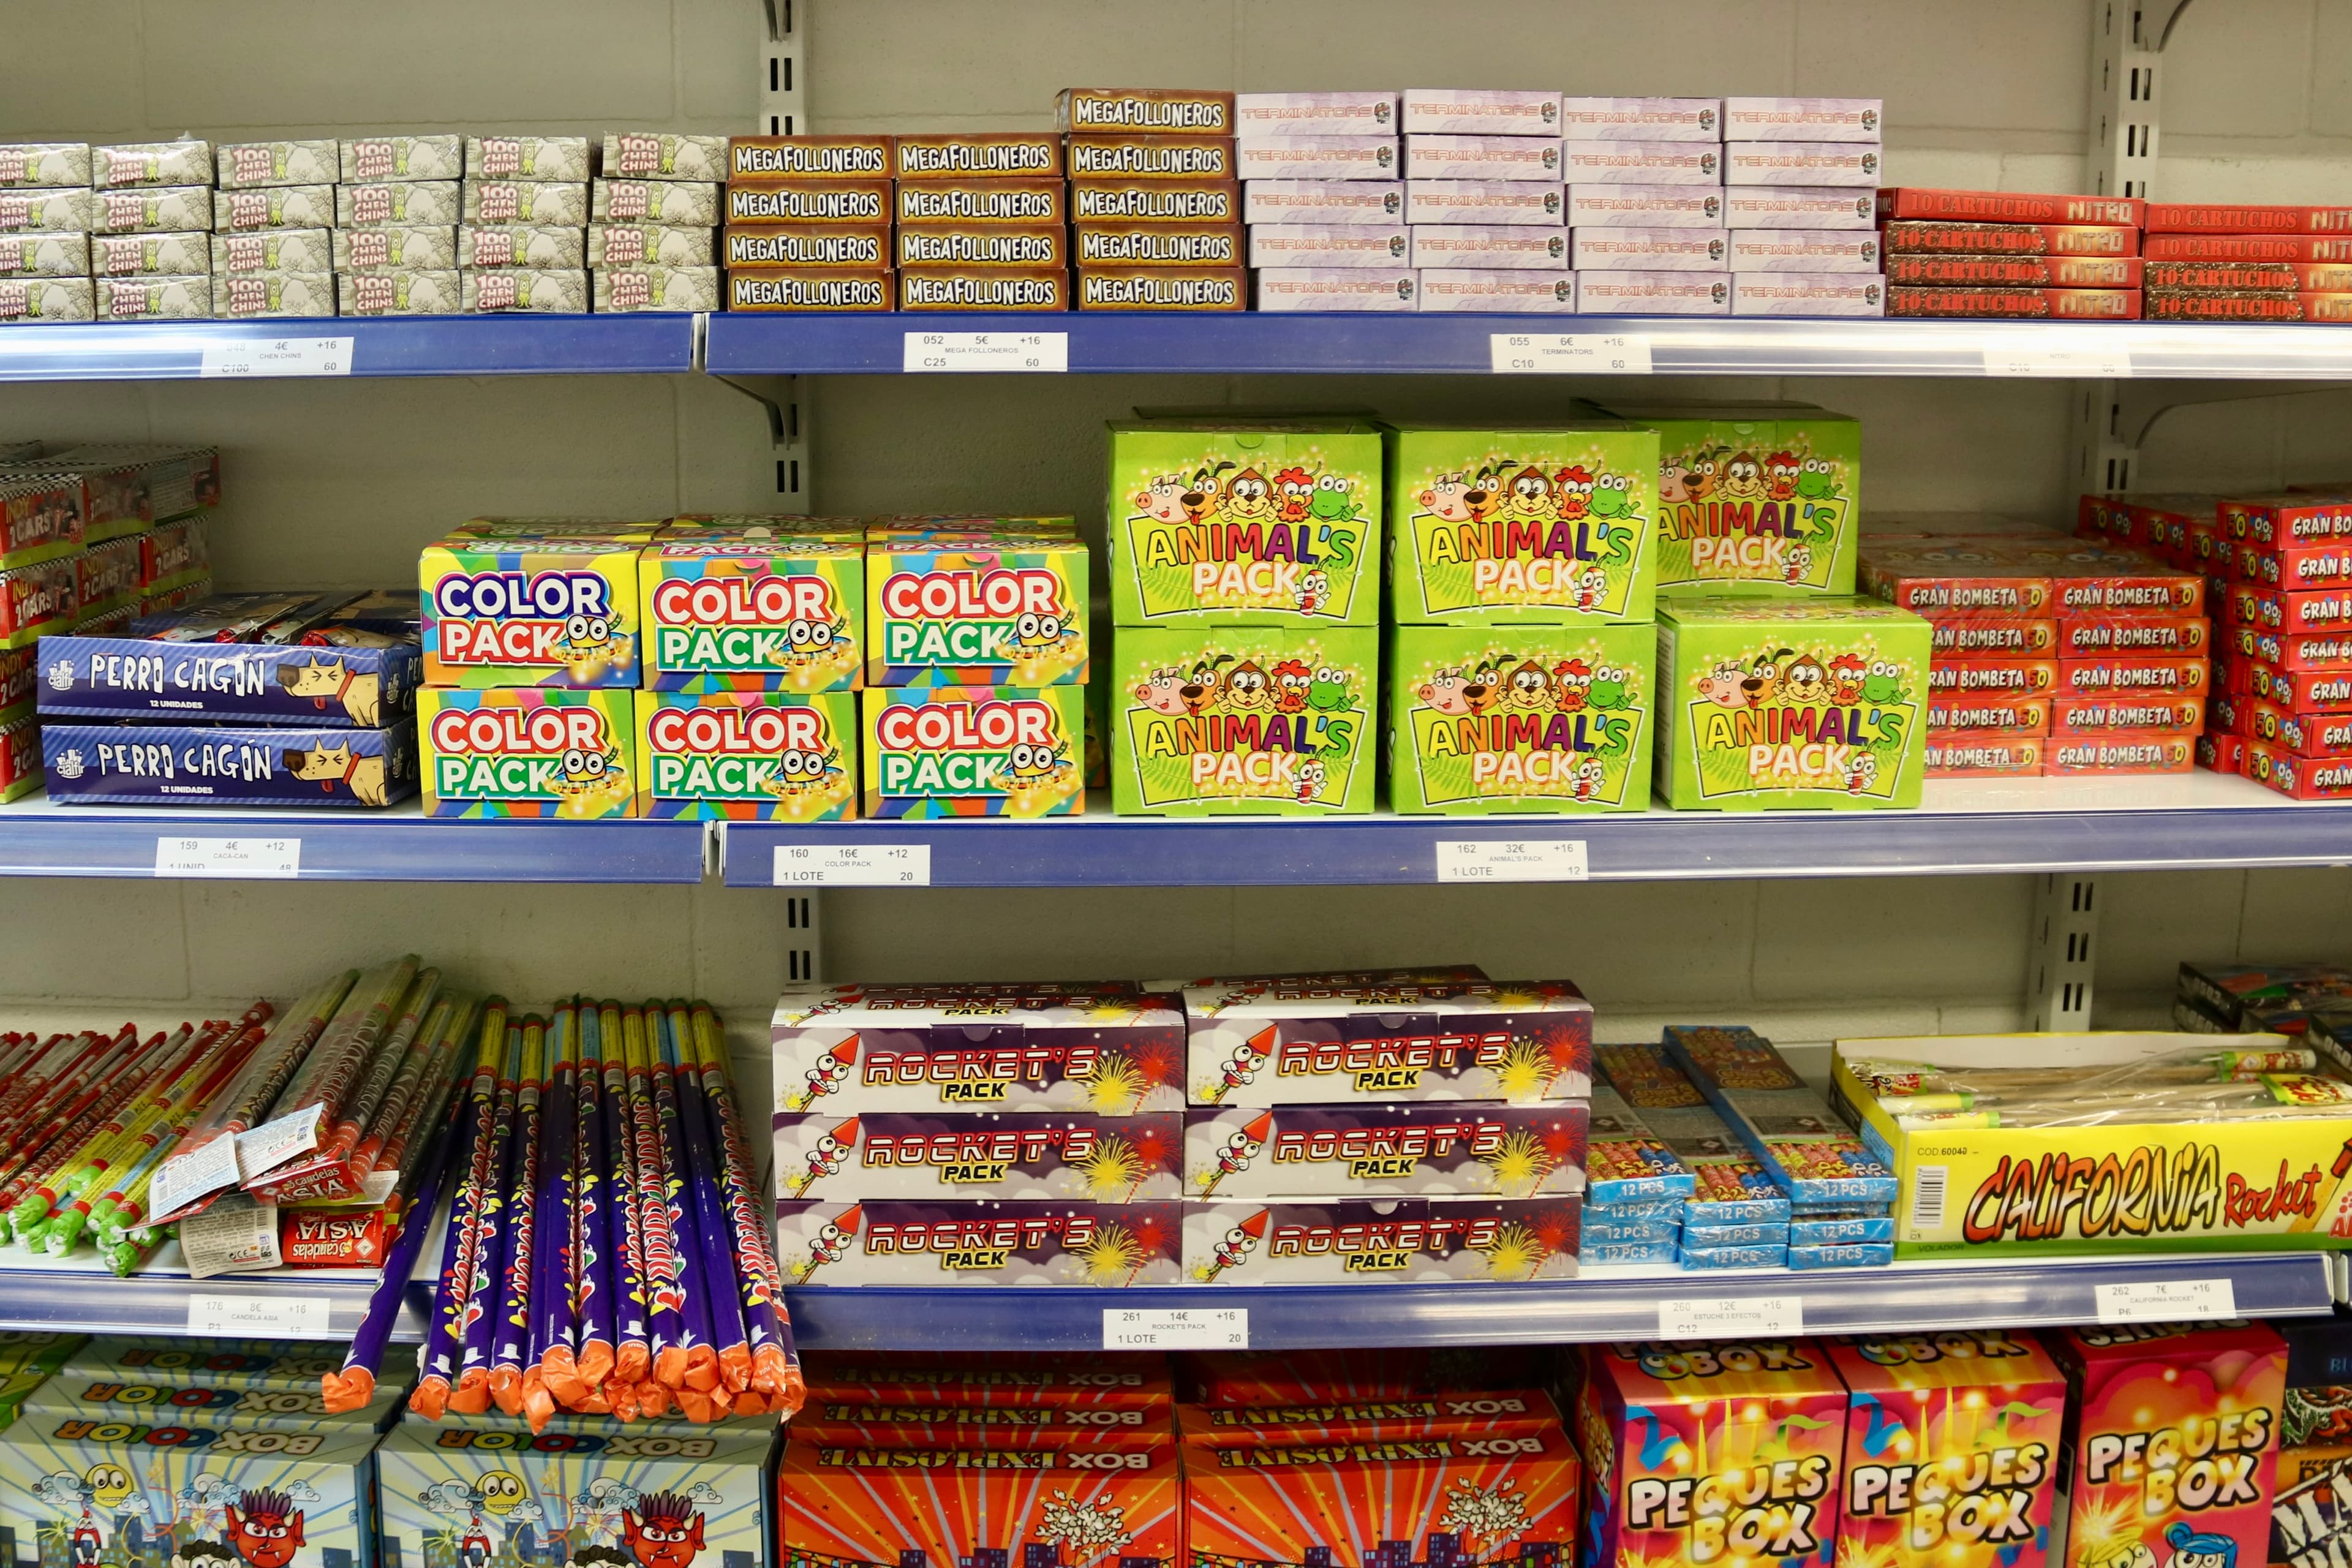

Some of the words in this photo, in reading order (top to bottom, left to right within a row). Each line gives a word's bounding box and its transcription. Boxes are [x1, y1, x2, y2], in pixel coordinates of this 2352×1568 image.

[1076, 98, 1223, 128] MEGAFOLLONEROS
[1242, 107, 1372, 119] TERMINATORS
[1411, 104, 1540, 116] TERMINATORS
[1567, 111, 1697, 124] TERMINATORS
[1732, 111, 1862, 124] TERMINATORS
[620, 138, 658, 153] 100
[233, 148, 271, 162] 100
[622, 150, 658, 162] CHEN
[736, 145, 884, 173] MEGAFOLLONEROS
[902, 145, 1050, 172] MEGAFOLLONEROS
[236, 159, 271, 171] CHEN
[622, 159, 658, 172] CHINS
[236, 167, 271, 182] CHINS
[1910, 194, 1932, 213] 10
[1938, 195, 2053, 218] CARTUCHOS
[2068, 202, 2132, 222] NITRO
[1086, 278, 1234, 304] MEGAFOLLONEROS
[1740, 287, 1865, 299] TERMINATORS
[1898, 293, 1917, 311] 10
[1924, 293, 2044, 313] CARTUCHOS
[2059, 295, 2127, 315] NITRO
[275, 342, 288, 350] 4€
[317, 341, 336, 349] +16
[924, 336, 944, 344] 052
[975, 336, 989, 344] 5€
[1020, 336, 1040, 345] +16
[1510, 337, 1529, 345] 055
[1560, 337, 1574, 345] 6€
[1604, 337, 1624, 346] +16
[222, 364, 249, 372] C100
[324, 362, 336, 371] 60
[924, 358, 946, 366] C25
[1026, 358, 1039, 367] 60
[1512, 359, 1534, 368] C10
[1611, 360, 1624, 368] 60
[1148, 521, 1355, 568] ANIMAL'S
[1193, 560, 1302, 596] PACK
[884, 573, 1058, 620] COLOR
[1910, 588, 1948, 606] GRAN
[1952, 587, 2017, 606] BOMBETA
[2022, 587, 2042, 606] 50
[2065, 587, 2103, 606] GRAN
[2107, 587, 2169, 606] BOMBETA
[2174, 586, 2193, 605] 50
[888, 622, 1012, 662] PACK
[91, 654, 164, 693] PERRO
[160, 700, 203, 709] UNIDADES
[434, 710, 603, 753] COLOR
[1708, 707, 1905, 752] ANIMAL'S
[97, 743, 175, 780] PERRO
[1749, 744, 1849, 777] PACK
[438, 756, 559, 795] PACK
[171, 786, 214, 794] UNIDADES
[225, 842, 238, 850] 4€
[790, 849, 809, 858] 160
[839, 849, 858, 858] 16€
[888, 849, 908, 858] +12
[1457, 845, 1476, 853] 162
[1506, 844, 1525, 853] 32€
[1555, 844, 1573, 853] +16
[279, 864, 291, 873] 48
[1453, 867, 1458, 876] 1
[1462, 867, 1493, 875] LOTE
[1569, 867, 1580, 875] 12
[793, 872, 824, 880] LOTE
[900, 872, 913, 881] 20
[1280, 1033, 1509, 1075] ROCKET'S
[865, 1048, 1098, 1084] ROCKET'S
[1358, 1071, 1419, 1088] PACK
[944, 1082, 1007, 1099] PACK
[277, 1178, 348, 1204] ASIA
[1622, 1183, 1634, 1196] 12
[1638, 1181, 1664, 1194] PCS
[1825, 1185, 1838, 1196] 12
[1841, 1184, 1868, 1196] PCS
[296, 1220, 373, 1240] ASIA
[2113, 1287, 2130, 1295] 262
[2156, 1285, 2166, 1294] 7€
[2193, 1284, 2210, 1292] +16
[206, 1302, 223, 1310] 176
[250, 1303, 262, 1312] 8€
[289, 1305, 306, 1314] +16
[1673, 1303, 1691, 1311] 260
[1719, 1302, 1736, 1311] 12€
[1763, 1301, 1781, 1310] +16
[1123, 1313, 1140, 1321] 261
[1170, 1312, 1188, 1321] 14€
[1216, 1312, 1235, 1321] +16
[208, 1323, 221, 1332] P3
[1678, 1324, 1697, 1333] C12
[1127, 1335, 1156, 1343] LOTE
[1229, 1334, 1241, 1343] 20
[55, 1420, 216, 1447] COLOR
[210, 1431, 324, 1455] BOX
[2087, 1408, 2271, 1484] PEQUES
[818, 1449, 1057, 1469] EXPLOSIVE
[1068, 1452, 1149, 1469] BOX
[1629, 1455, 1830, 1529] PEQUES
[2144, 1453, 2260, 1517] BOX
[1692, 1502, 1817, 1564] BOX
